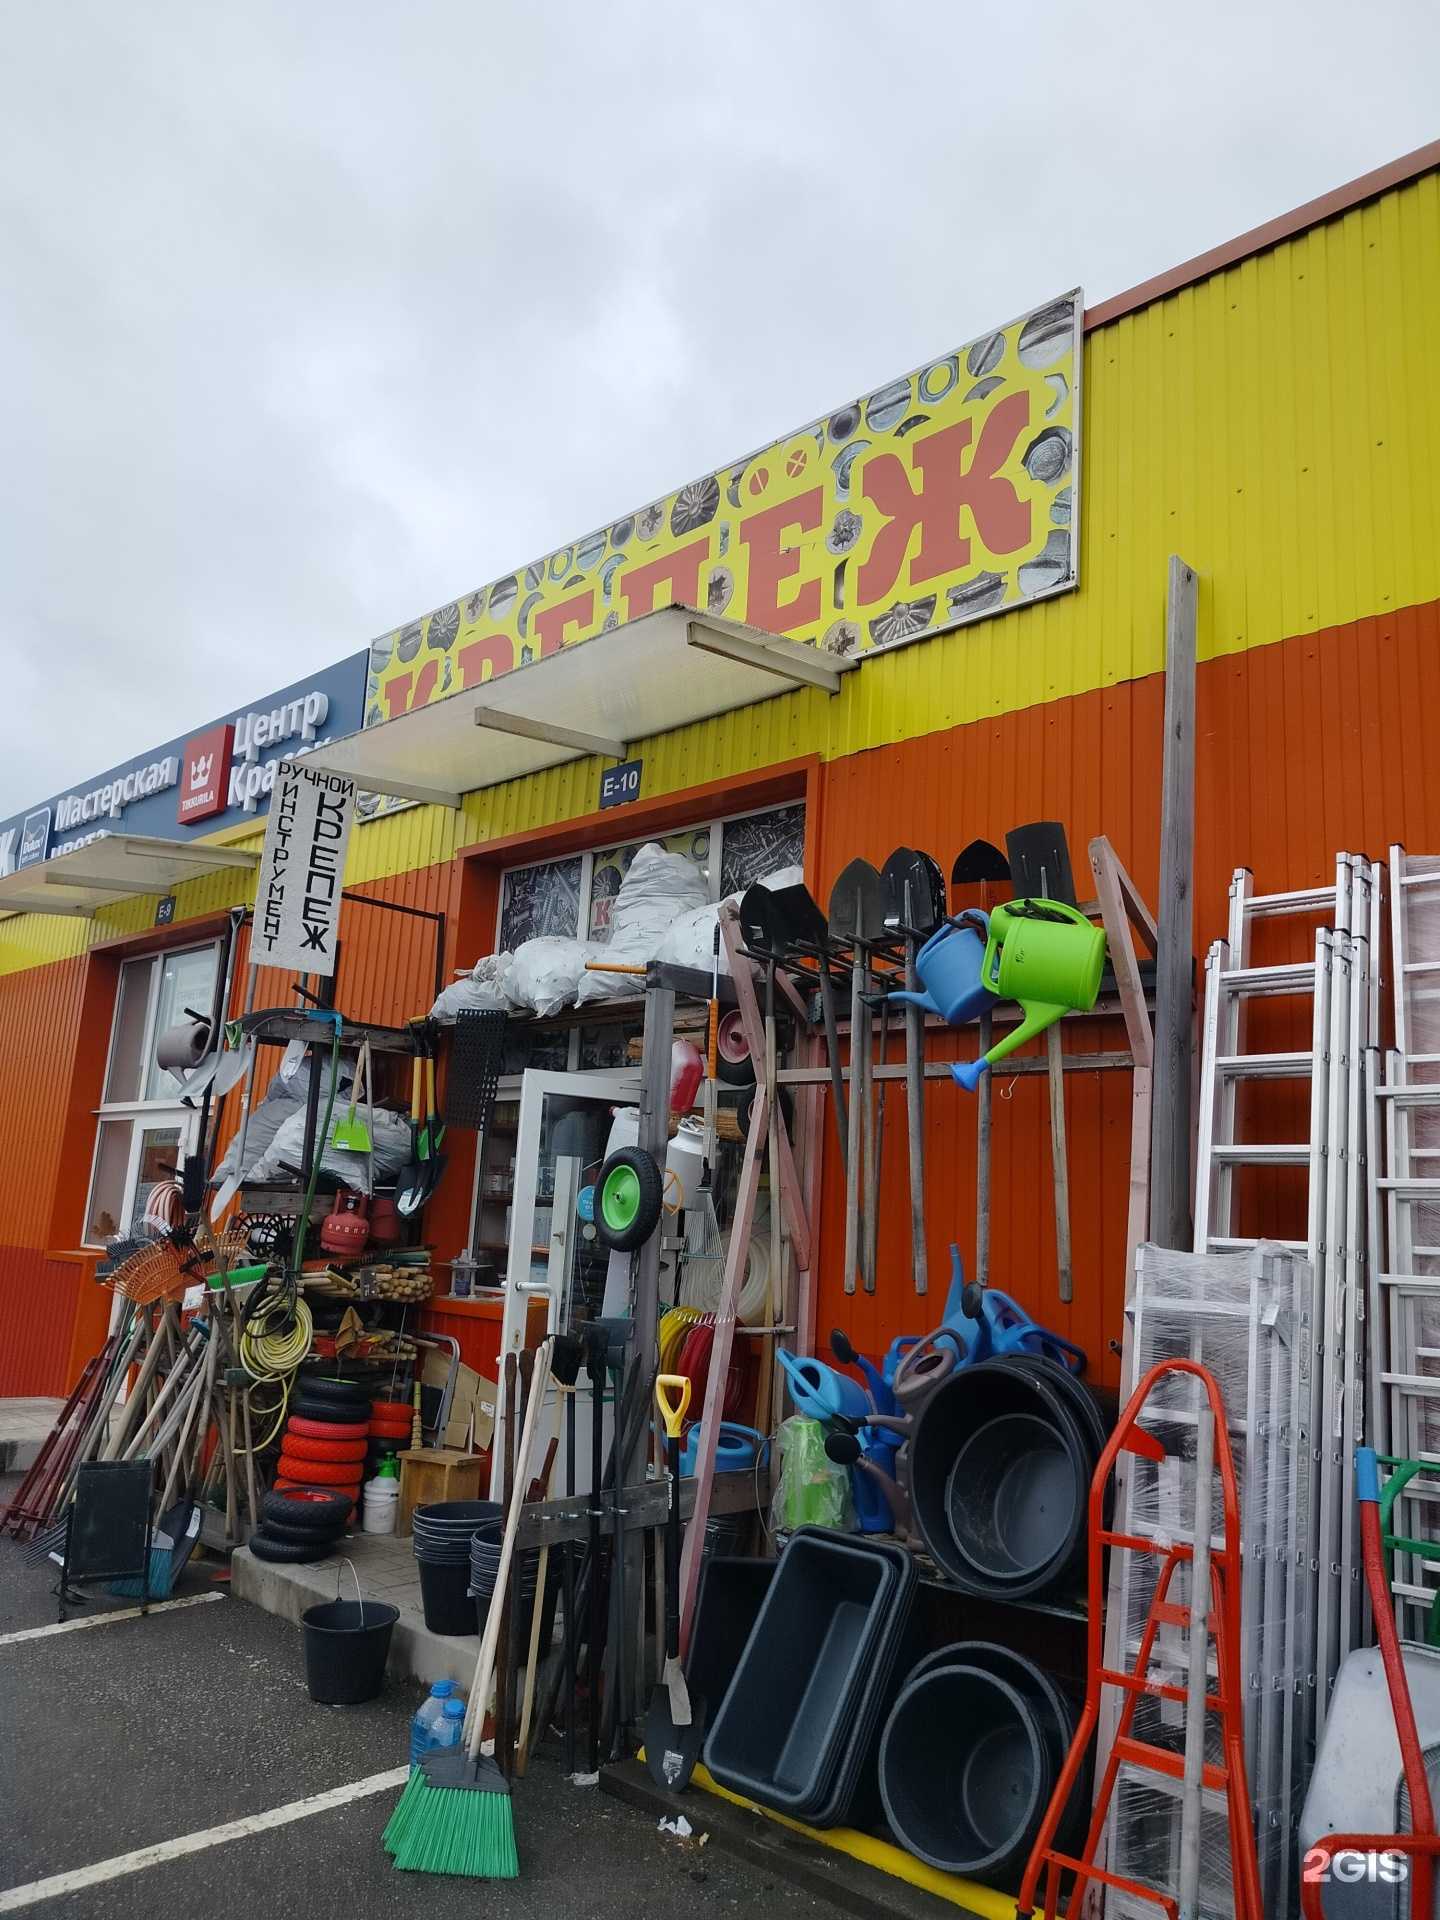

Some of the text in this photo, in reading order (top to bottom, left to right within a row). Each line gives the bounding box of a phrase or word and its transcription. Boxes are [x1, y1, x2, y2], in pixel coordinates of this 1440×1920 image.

[232, 691, 328, 762] Центр
[54, 757, 179, 831] Мастерская
[182, 790, 214, 812] TIKKURILA
[277, 761, 355, 797] РУЧНОЙ
[603, 770, 638, 797] Е-10
[263, 781, 299, 952] ИНСТРУМЕНТ
[299, 791, 347, 954] КРЕПЕЖ
[158, 903, 172, 919] Е-9
